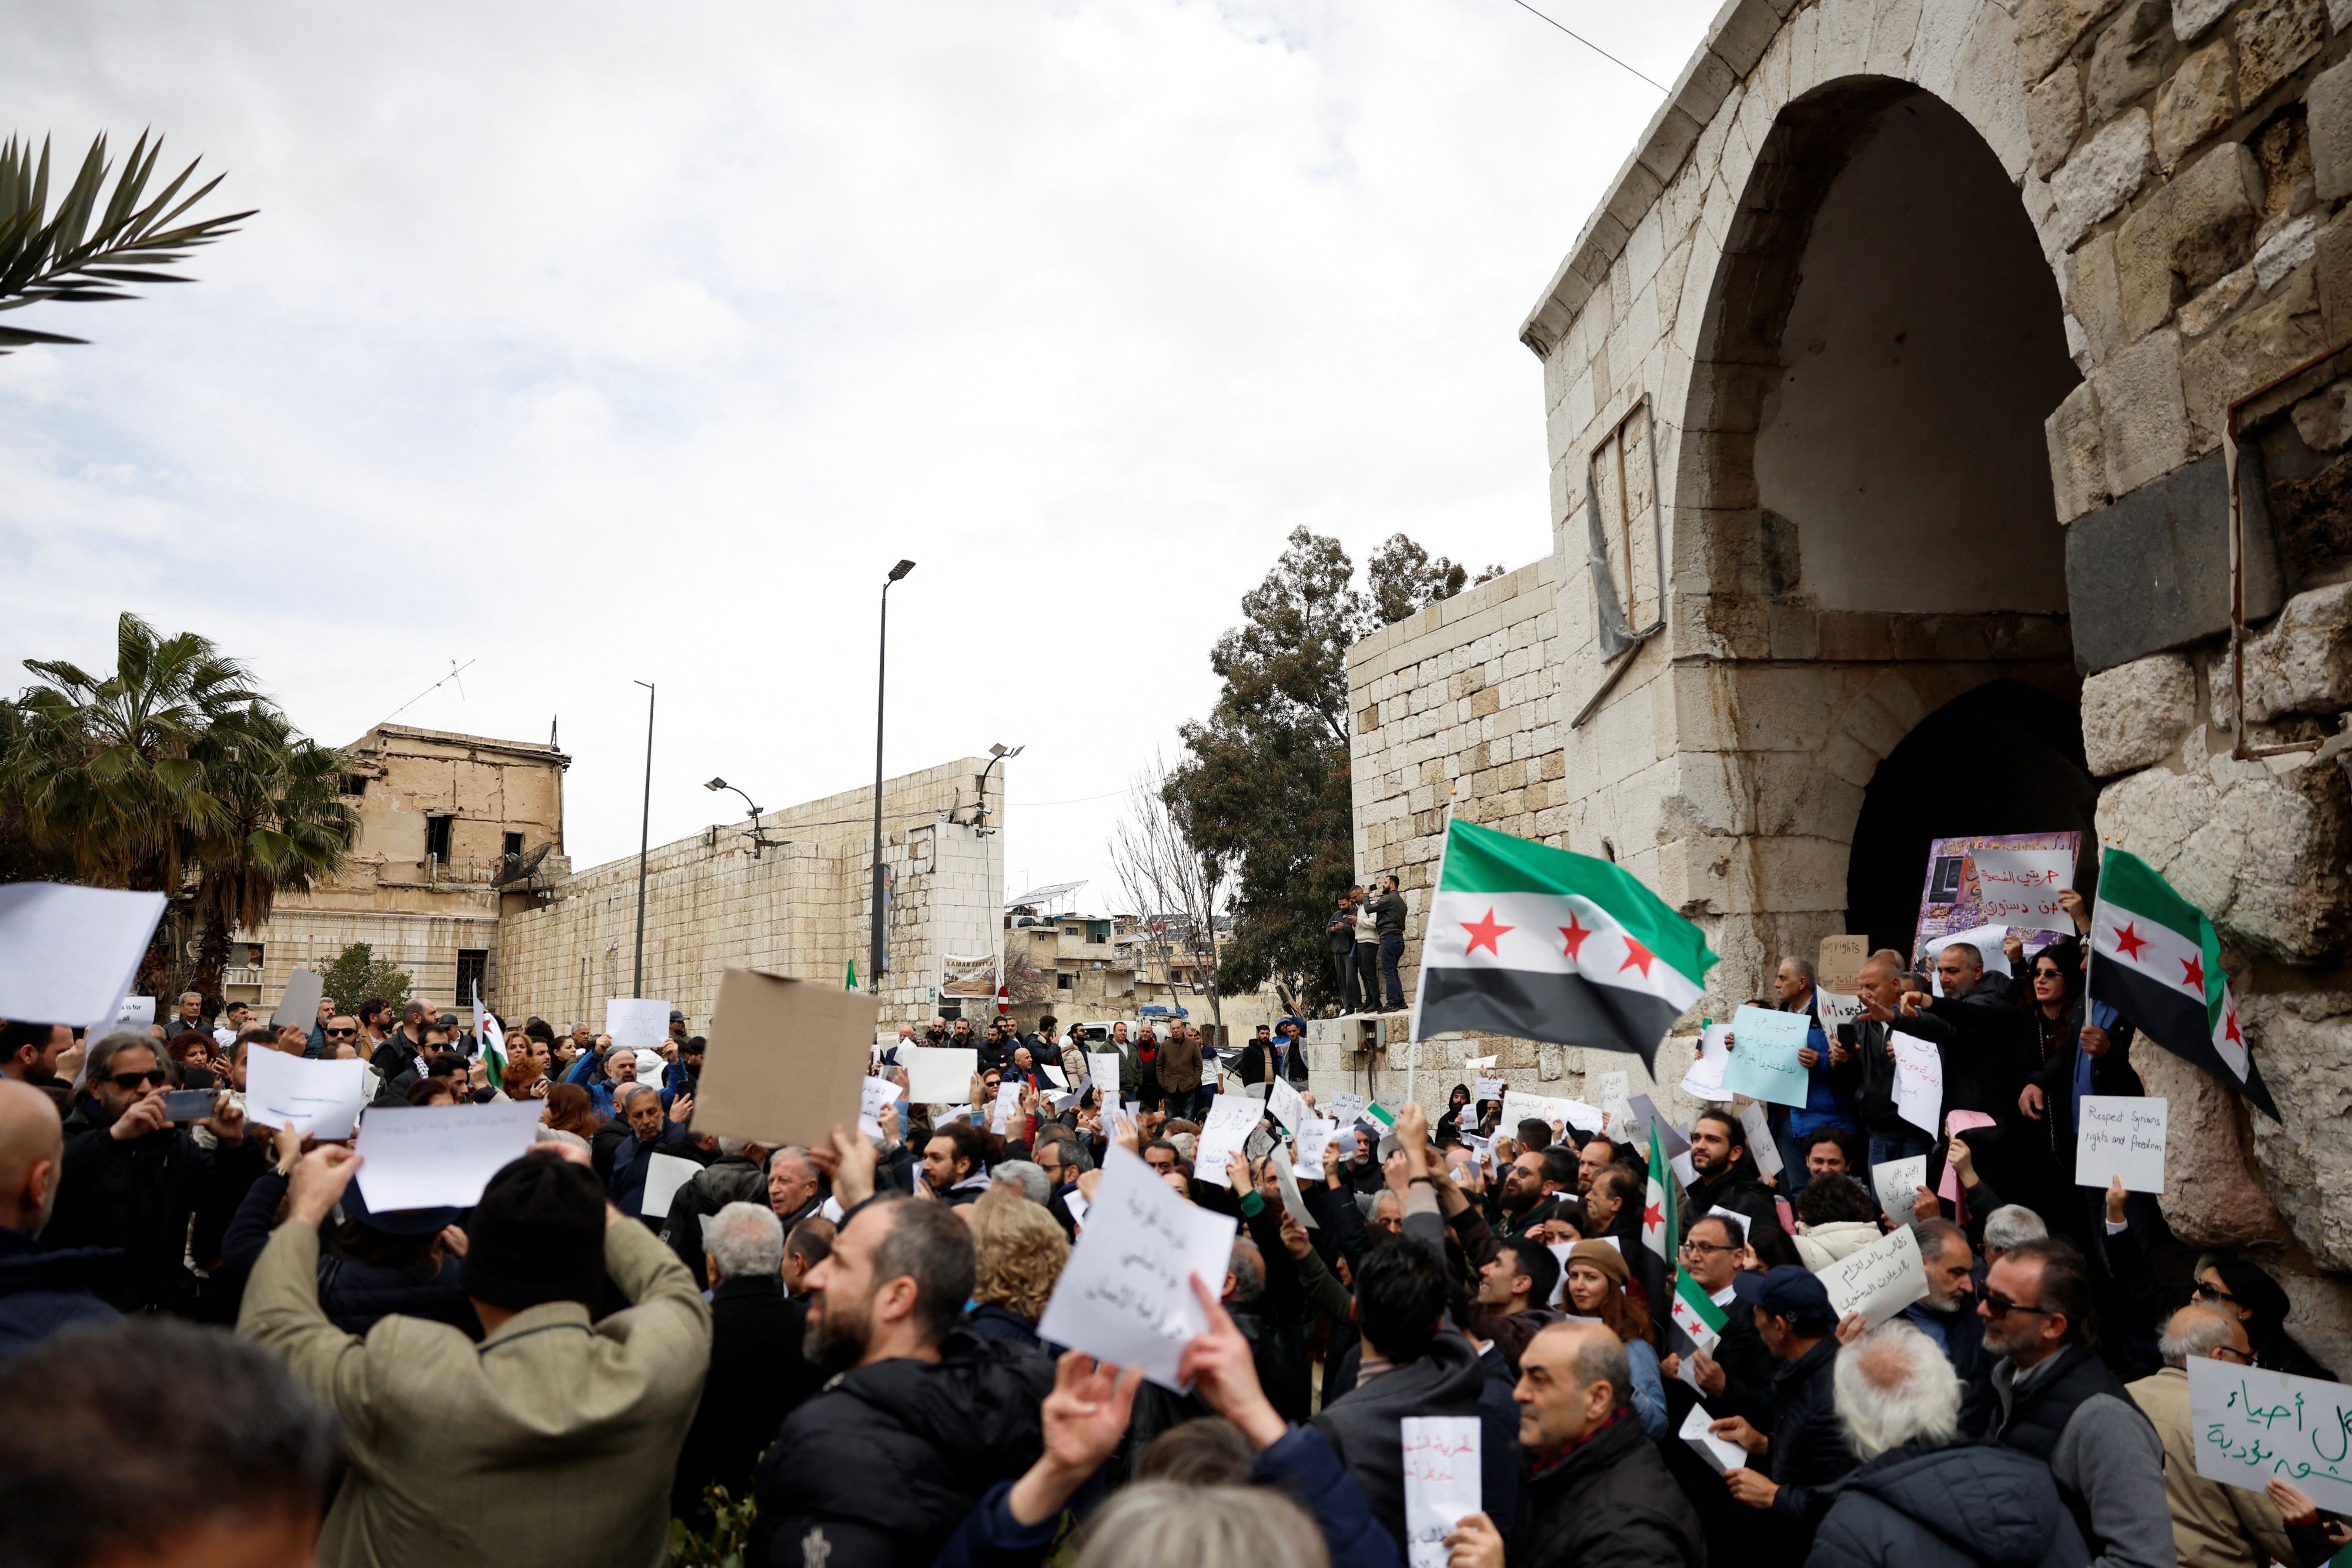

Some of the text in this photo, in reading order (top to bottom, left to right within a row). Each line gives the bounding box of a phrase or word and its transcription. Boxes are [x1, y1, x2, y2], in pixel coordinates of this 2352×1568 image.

[1981, 870, 2059, 887] حريتي الشخصية
[1985, 900, 2029, 917] دستوري
[1835, 941, 1860, 955] rights
[1836, 974, 1859, 986] Justic
[1821, 996, 1832, 1018] No
[1845, 1001, 1863, 1016] sect
[2089, 1105, 2160, 1131] Respect Syrians
[2086, 1130, 2161, 1152] rights and freedom
[1886, 1236, 1907, 1259] نطالب
[2227, 1379, 2304, 1432] أحياء
[2207, 1424, 2273, 1465] مؤدبة
